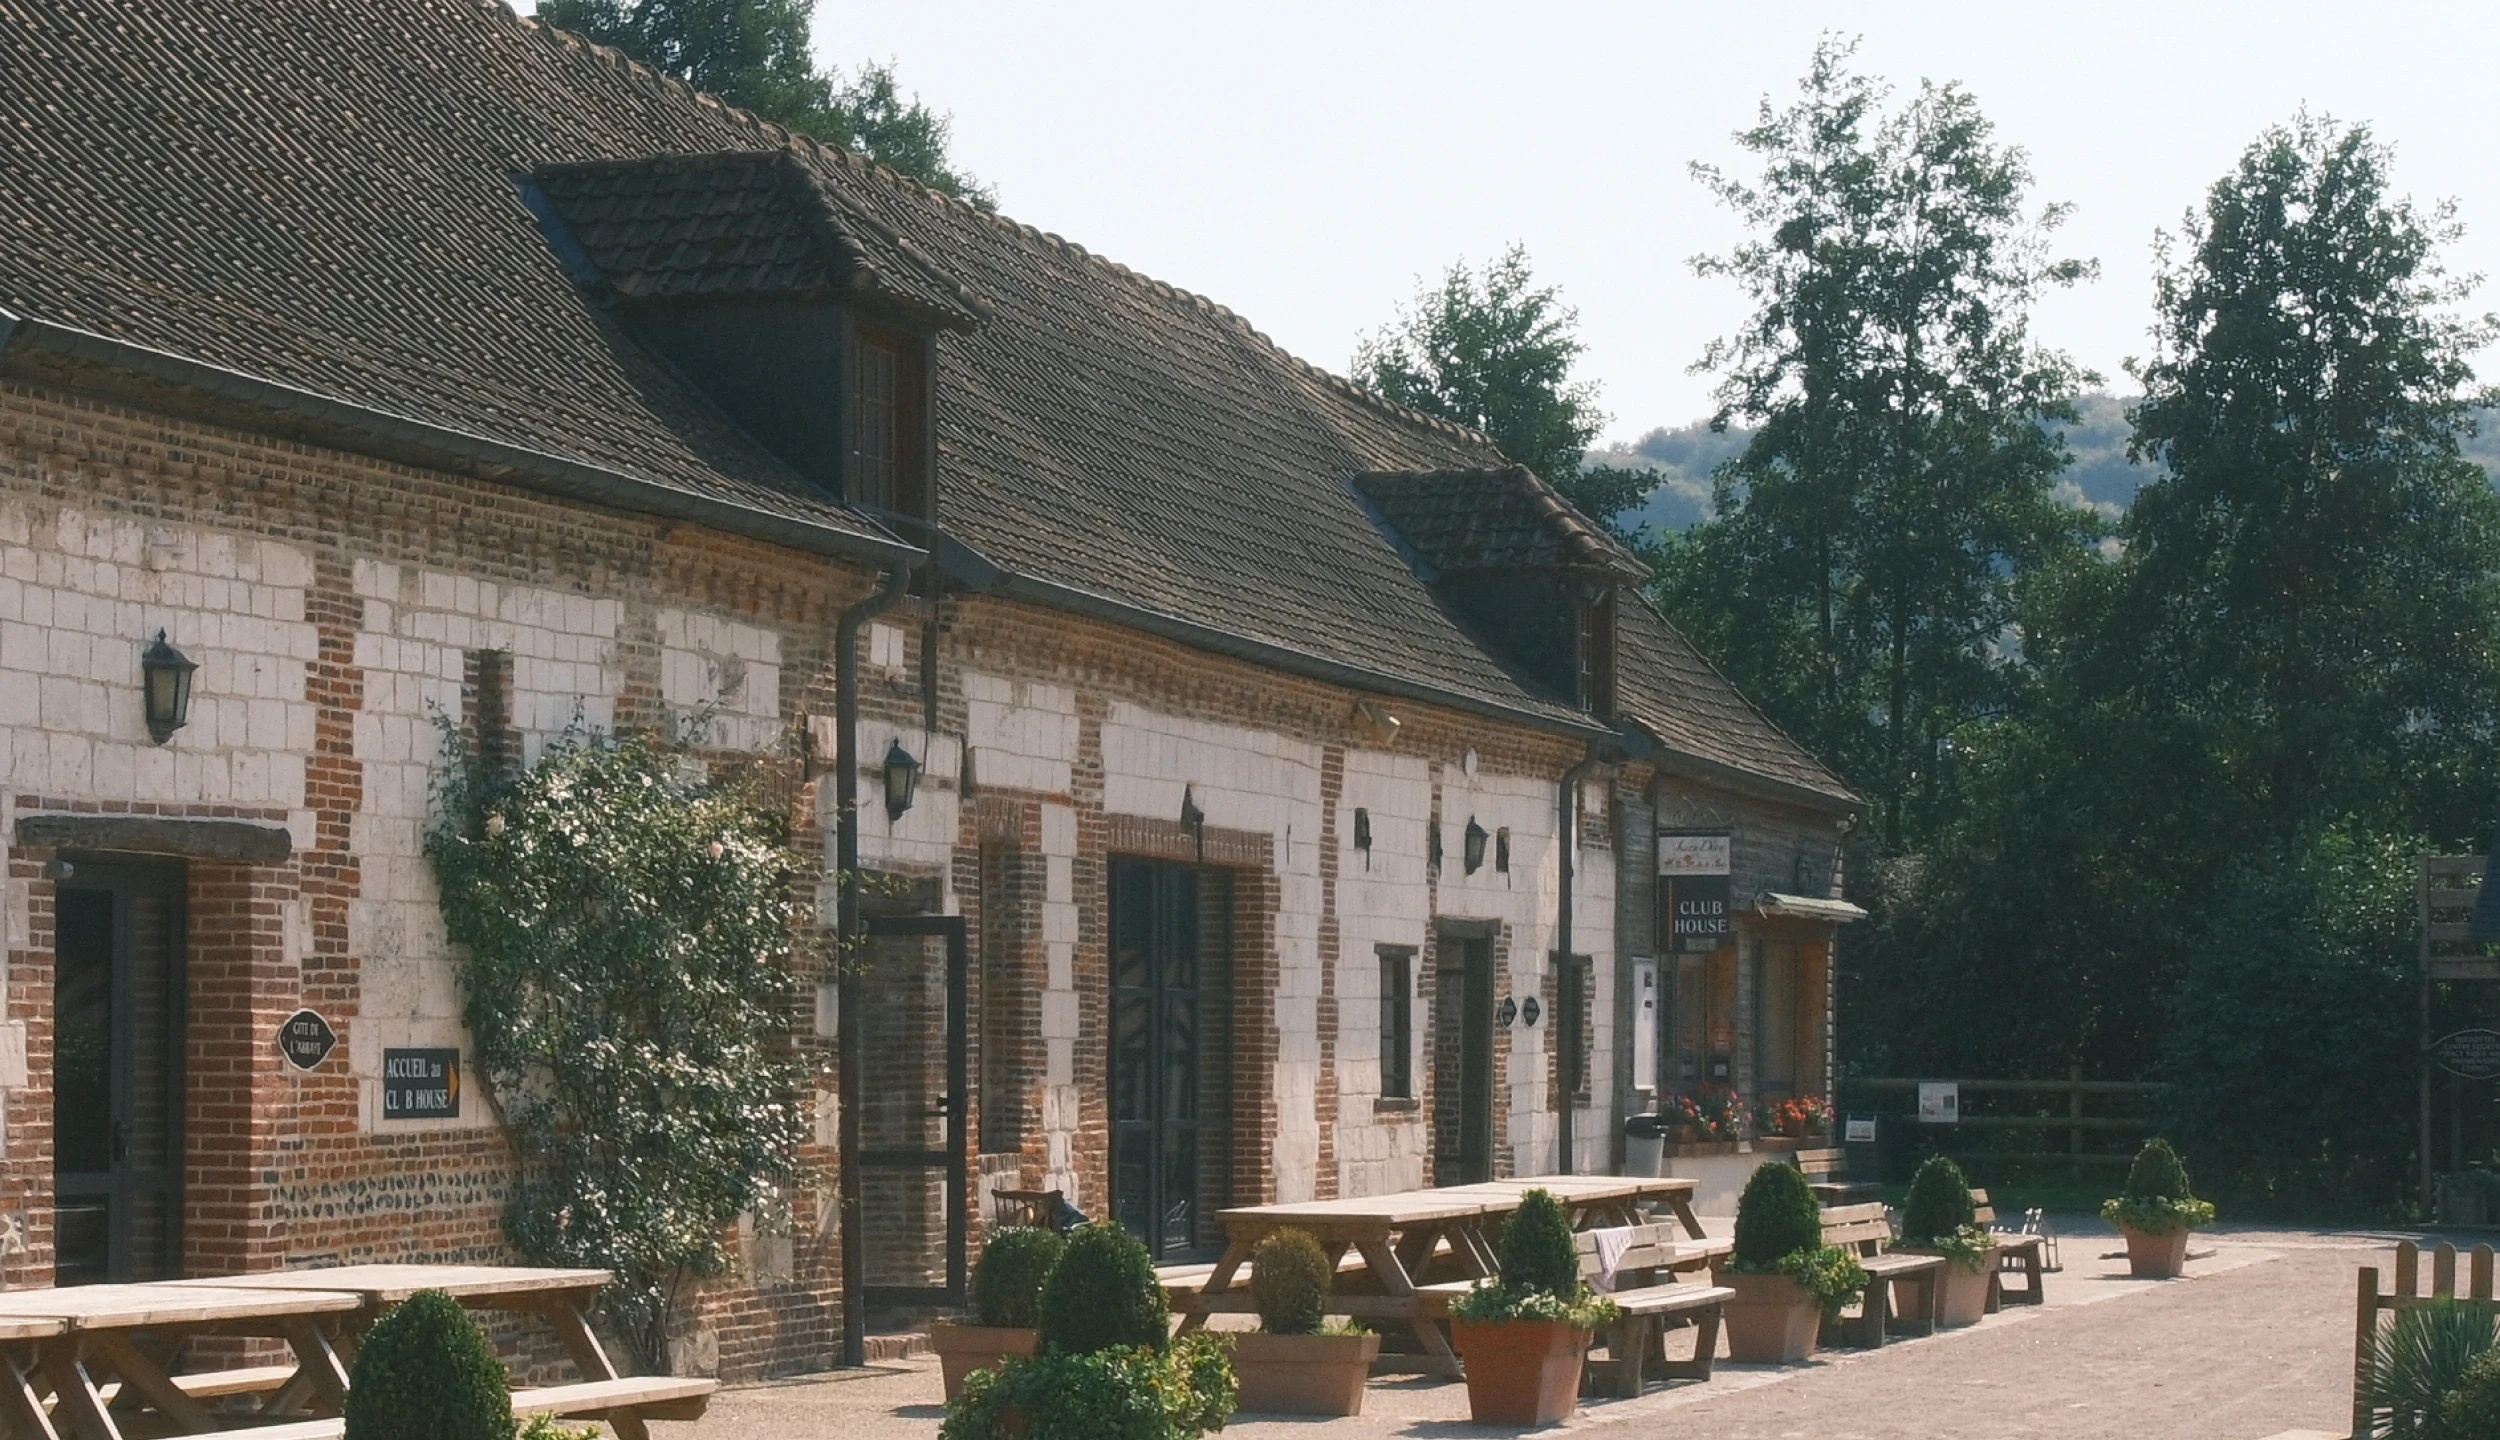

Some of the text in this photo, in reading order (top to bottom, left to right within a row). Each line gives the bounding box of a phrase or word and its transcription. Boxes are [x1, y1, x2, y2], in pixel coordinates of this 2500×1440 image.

[1680, 901, 1723, 915] CLUB
[1674, 919, 1727, 934] HOUSE
[386, 1058, 429, 1078] ACCUEIL
[415, 1088, 449, 1110] HOUSE
